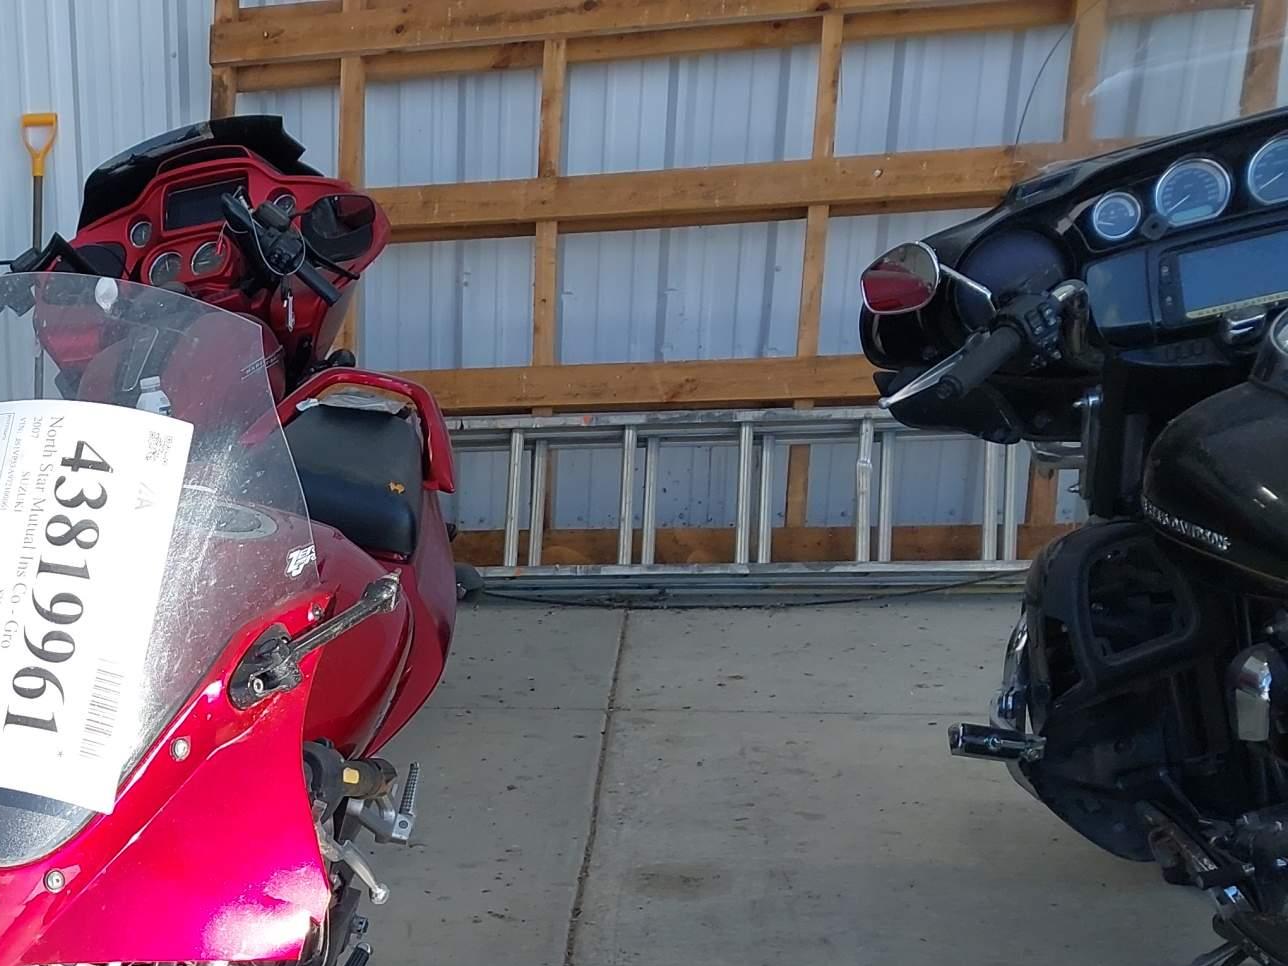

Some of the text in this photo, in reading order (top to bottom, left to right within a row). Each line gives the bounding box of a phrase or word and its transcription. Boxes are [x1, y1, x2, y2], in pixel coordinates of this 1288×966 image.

[31, 416, 43, 438] 2007
[42, 416, 64, 458] North
[14, 471, 31, 512] SUZUKI
[36, 463, 54, 493] Star
[22, 497, 47, 550] Mutual
[16, 556, 34, 577] Ins
[3, 440, 113, 735] 43819961
[11, 583, 28, 604] Co
[0, 620, 19, 648] Gro
